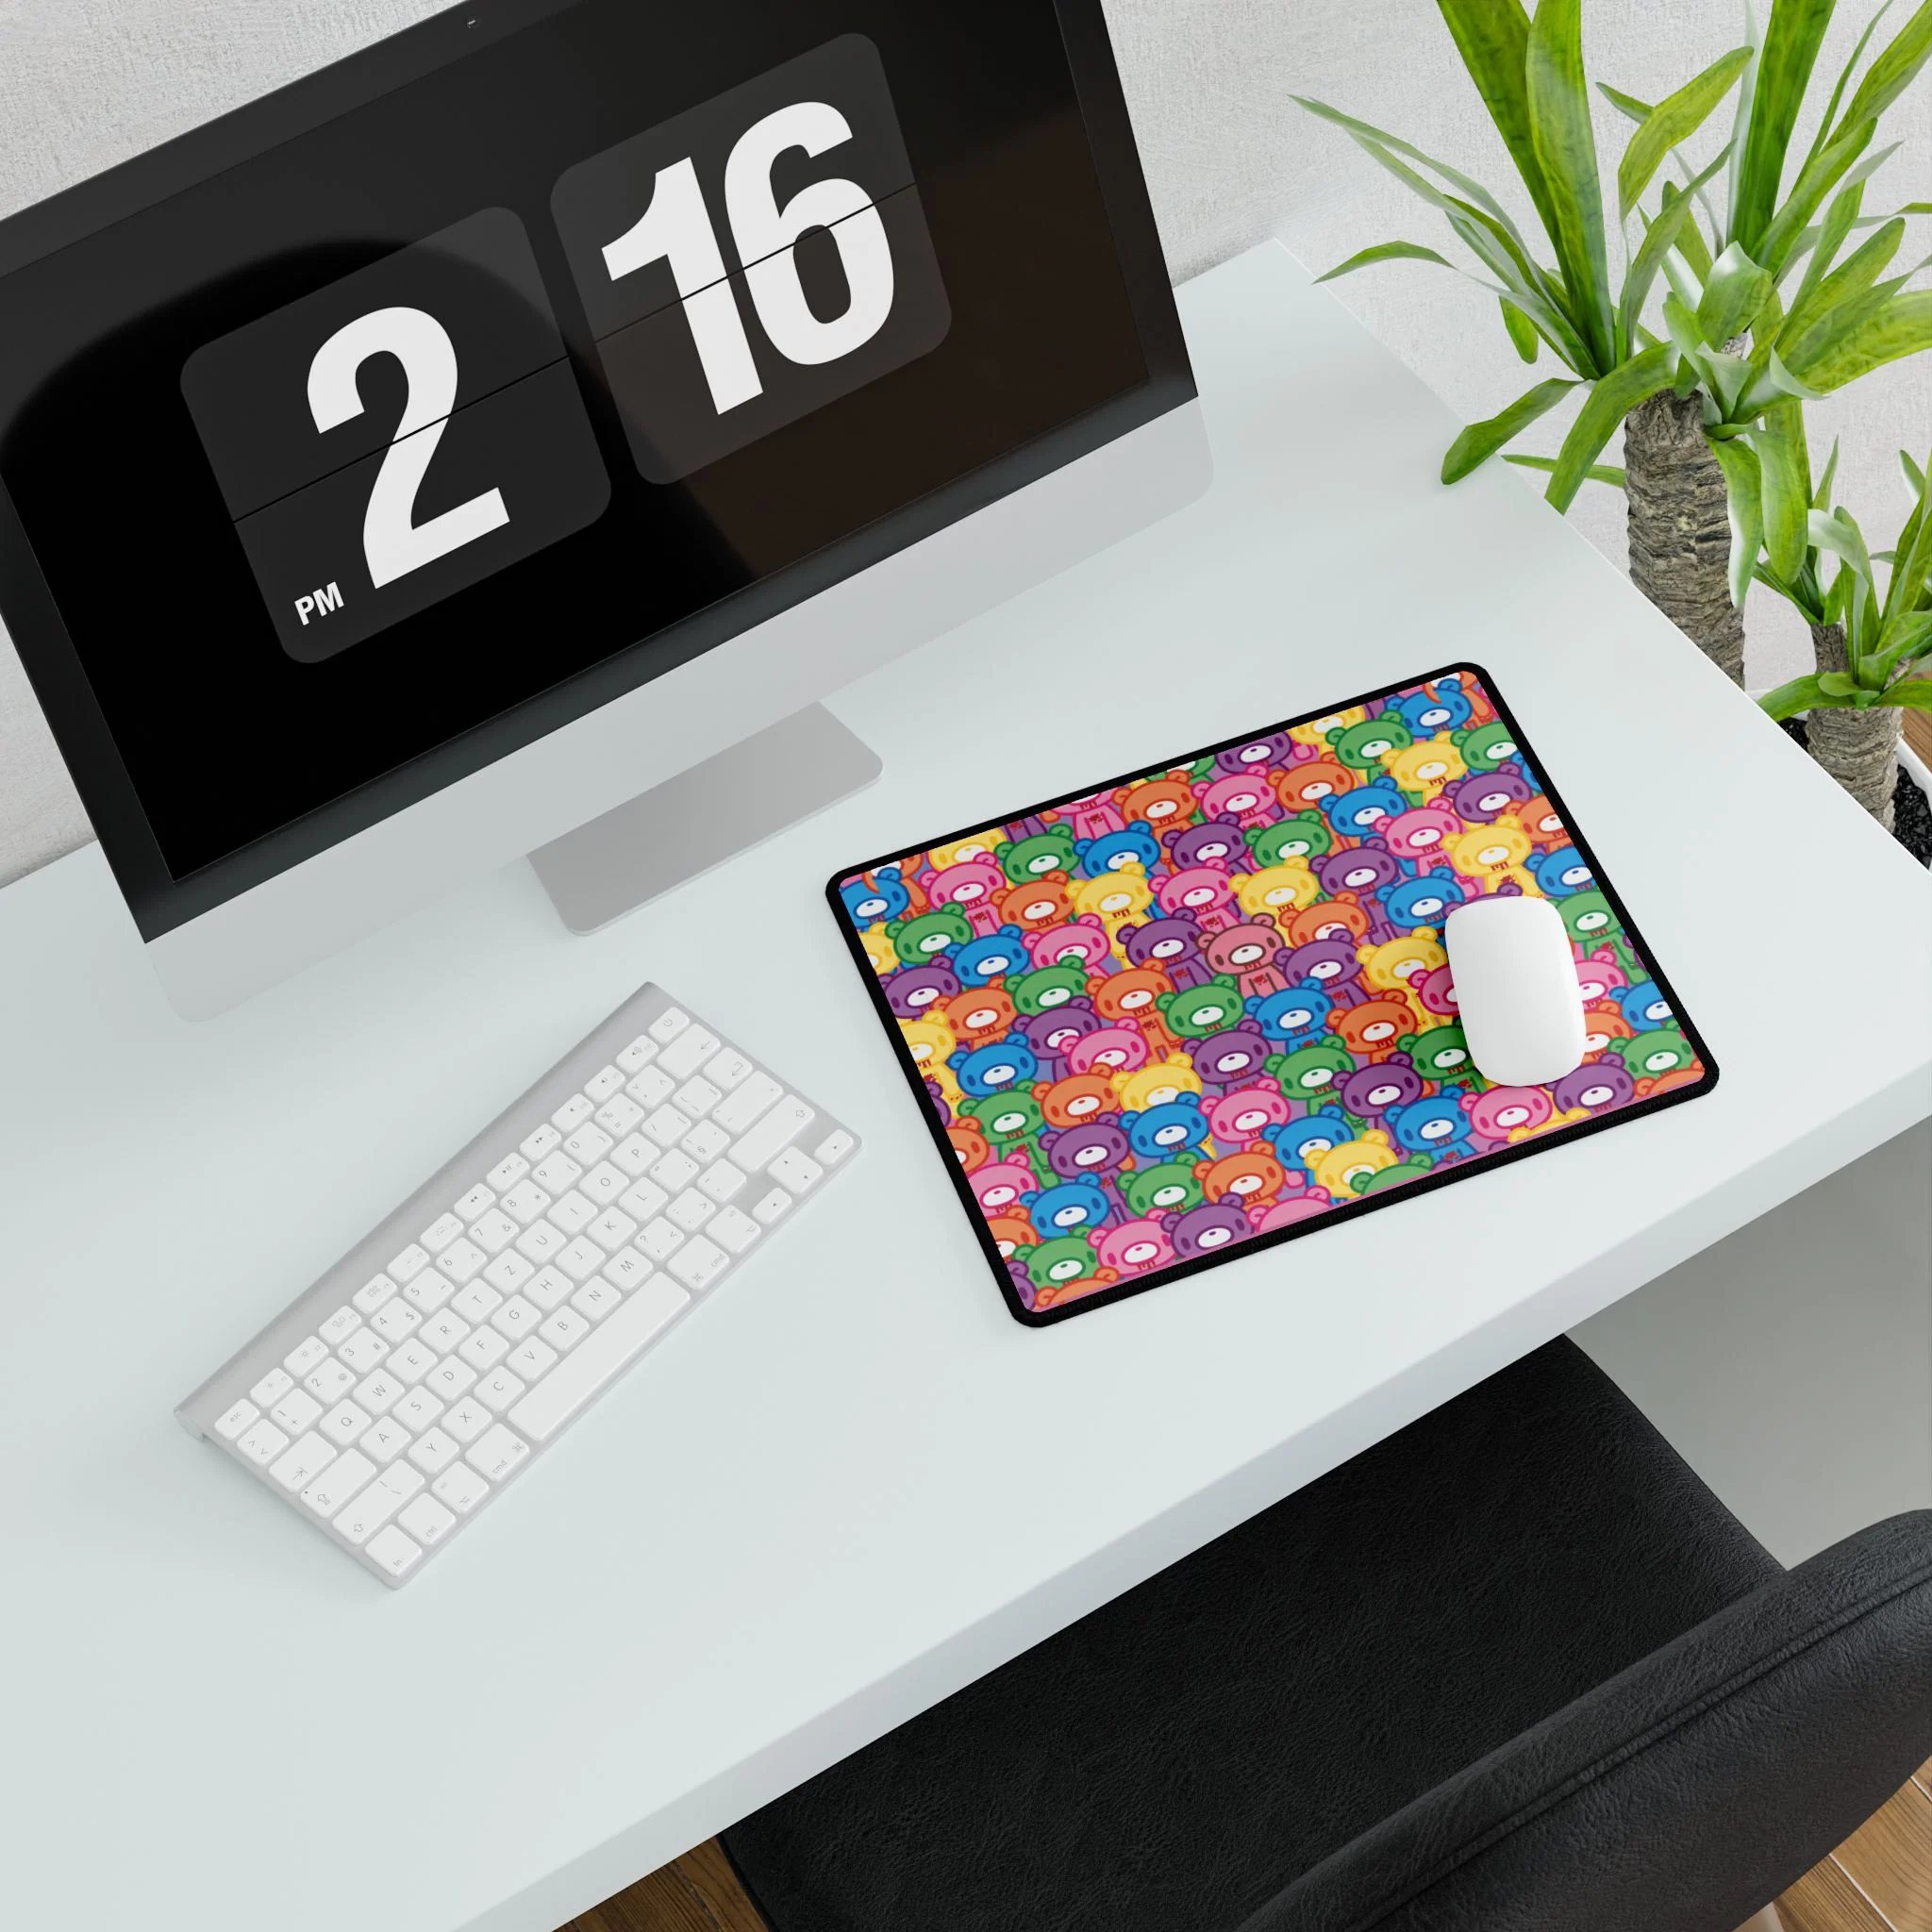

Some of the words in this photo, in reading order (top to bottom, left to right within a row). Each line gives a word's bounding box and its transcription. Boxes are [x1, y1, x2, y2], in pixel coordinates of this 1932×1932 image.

[308, 307, 510, 590] 2
[601, 101, 894, 415] 16
[294, 581, 344, 626] PM
[570, 1140, 580, 1150] 0
[630, 1148, 640, 1158] P
[539, 1170, 547, 1178] 9
[599, 1177, 611, 1187] O
[636, 1193, 647, 1202] L
[507, 1199, 517, 1208] 8
[604, 1221, 616, 1231] K
[474, 1227, 484, 1237] 7
[535, 1234, 551, 1246] U
[574, 1251, 584, 1260] J
[443, 1257, 453, 1267] 6
[620, 1259, 635, 1273] M
[504, 1264, 517, 1276] Z
[539, 1278, 554, 1291] H
[410, 1287, 421, 1297] 5
[588, 1290, 602, 1302] N
[472, 1294, 483, 1304] T
[508, 1309, 520, 1320] G
[379, 1316, 388, 1325] 4
[439, 1325, 451, 1335] R
[557, 1321, 568, 1331] B
[475, 1340, 486, 1350] F
[344, 1347, 355, 1357] 3
[524, 1350, 535, 1359] V
[407, 1355, 419, 1366] E
[442, 1371, 455, 1382] D
[310, 1377, 323, 1388] 2
[492, 1381, 505, 1391] C
[372, 1384, 386, 1397] W
[410, 1402, 422, 1411] S
[341, 1417, 354, 1427] Q
[459, 1411, 473, 1424] X
[378, 1433, 391, 1443] A
[425, 1442, 438, 1453] Y
